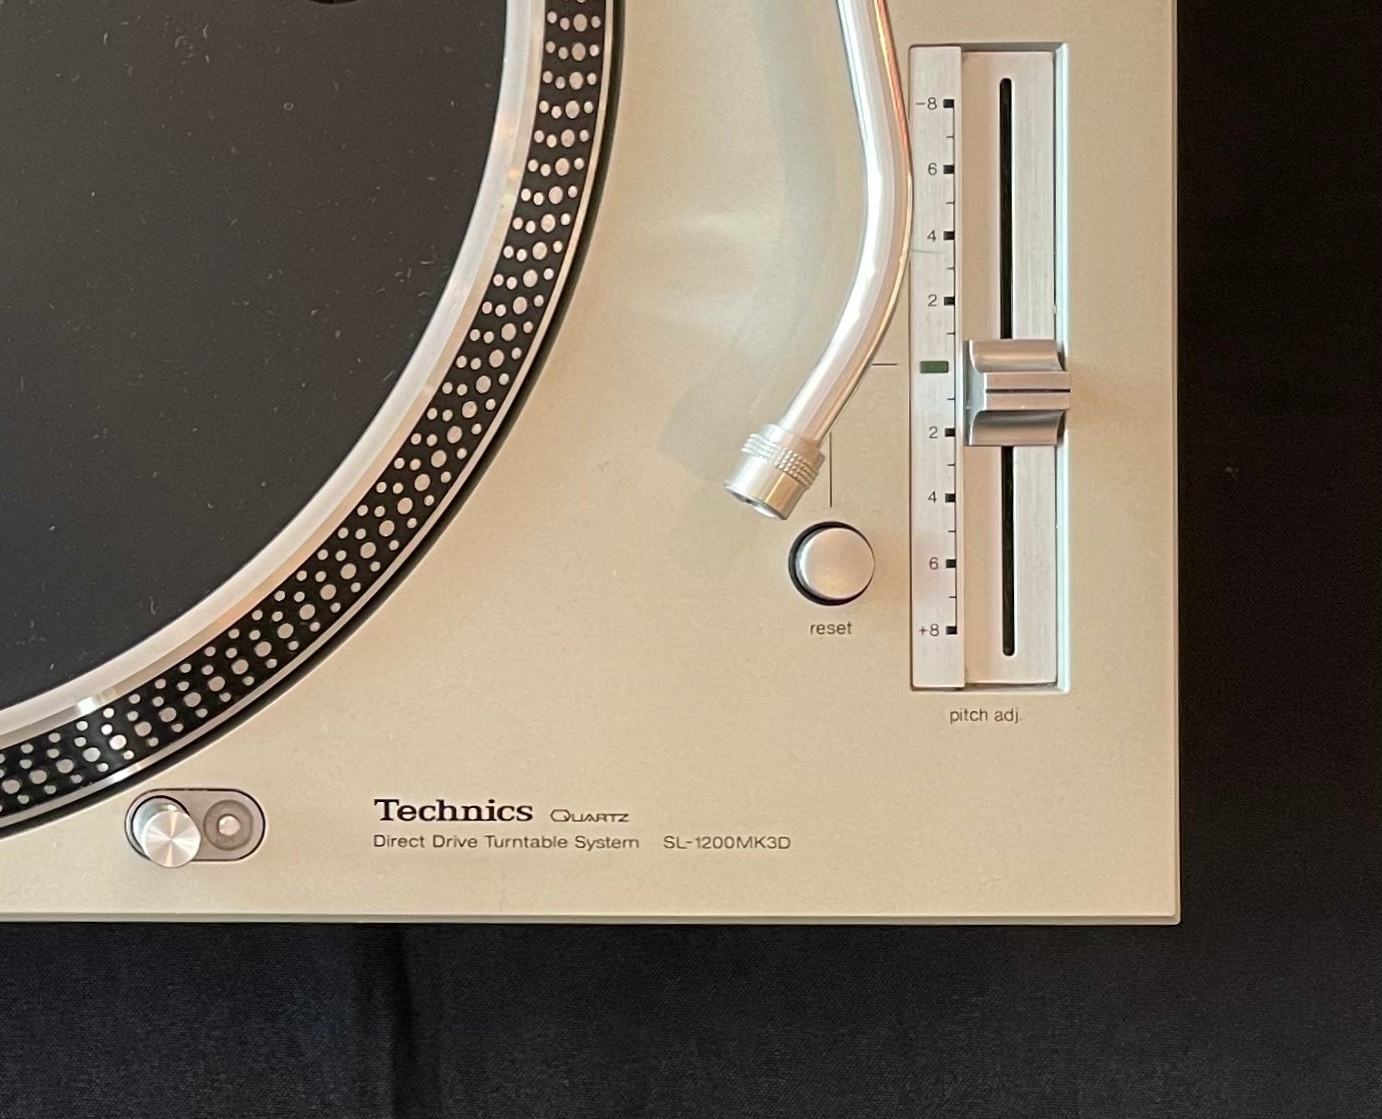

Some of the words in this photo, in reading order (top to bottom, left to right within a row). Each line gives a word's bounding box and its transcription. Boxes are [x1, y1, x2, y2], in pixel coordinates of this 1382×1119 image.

[915, 97, 938, 111] -8
[927, 162, 938, 176] 6
[926, 229, 937, 243] 4
[927, 294, 938, 307] 2
[928, 426, 939, 439] 2
[927, 490, 937, 503] 4
[928, 557, 939, 570] 6
[810, 622, 853, 635] reset
[918, 623, 940, 637] +8
[949, 707, 988, 725] pitch
[994, 707, 1023, 723] adj.
[373, 798, 533, 822] Technics
[373, 834, 425, 849] Direct
[432, 835, 478, 849] Drive
[483, 835, 568, 849] Turntable
[574, 835, 640, 852] System
[662, 835, 792, 850] SL-1200MK3D
